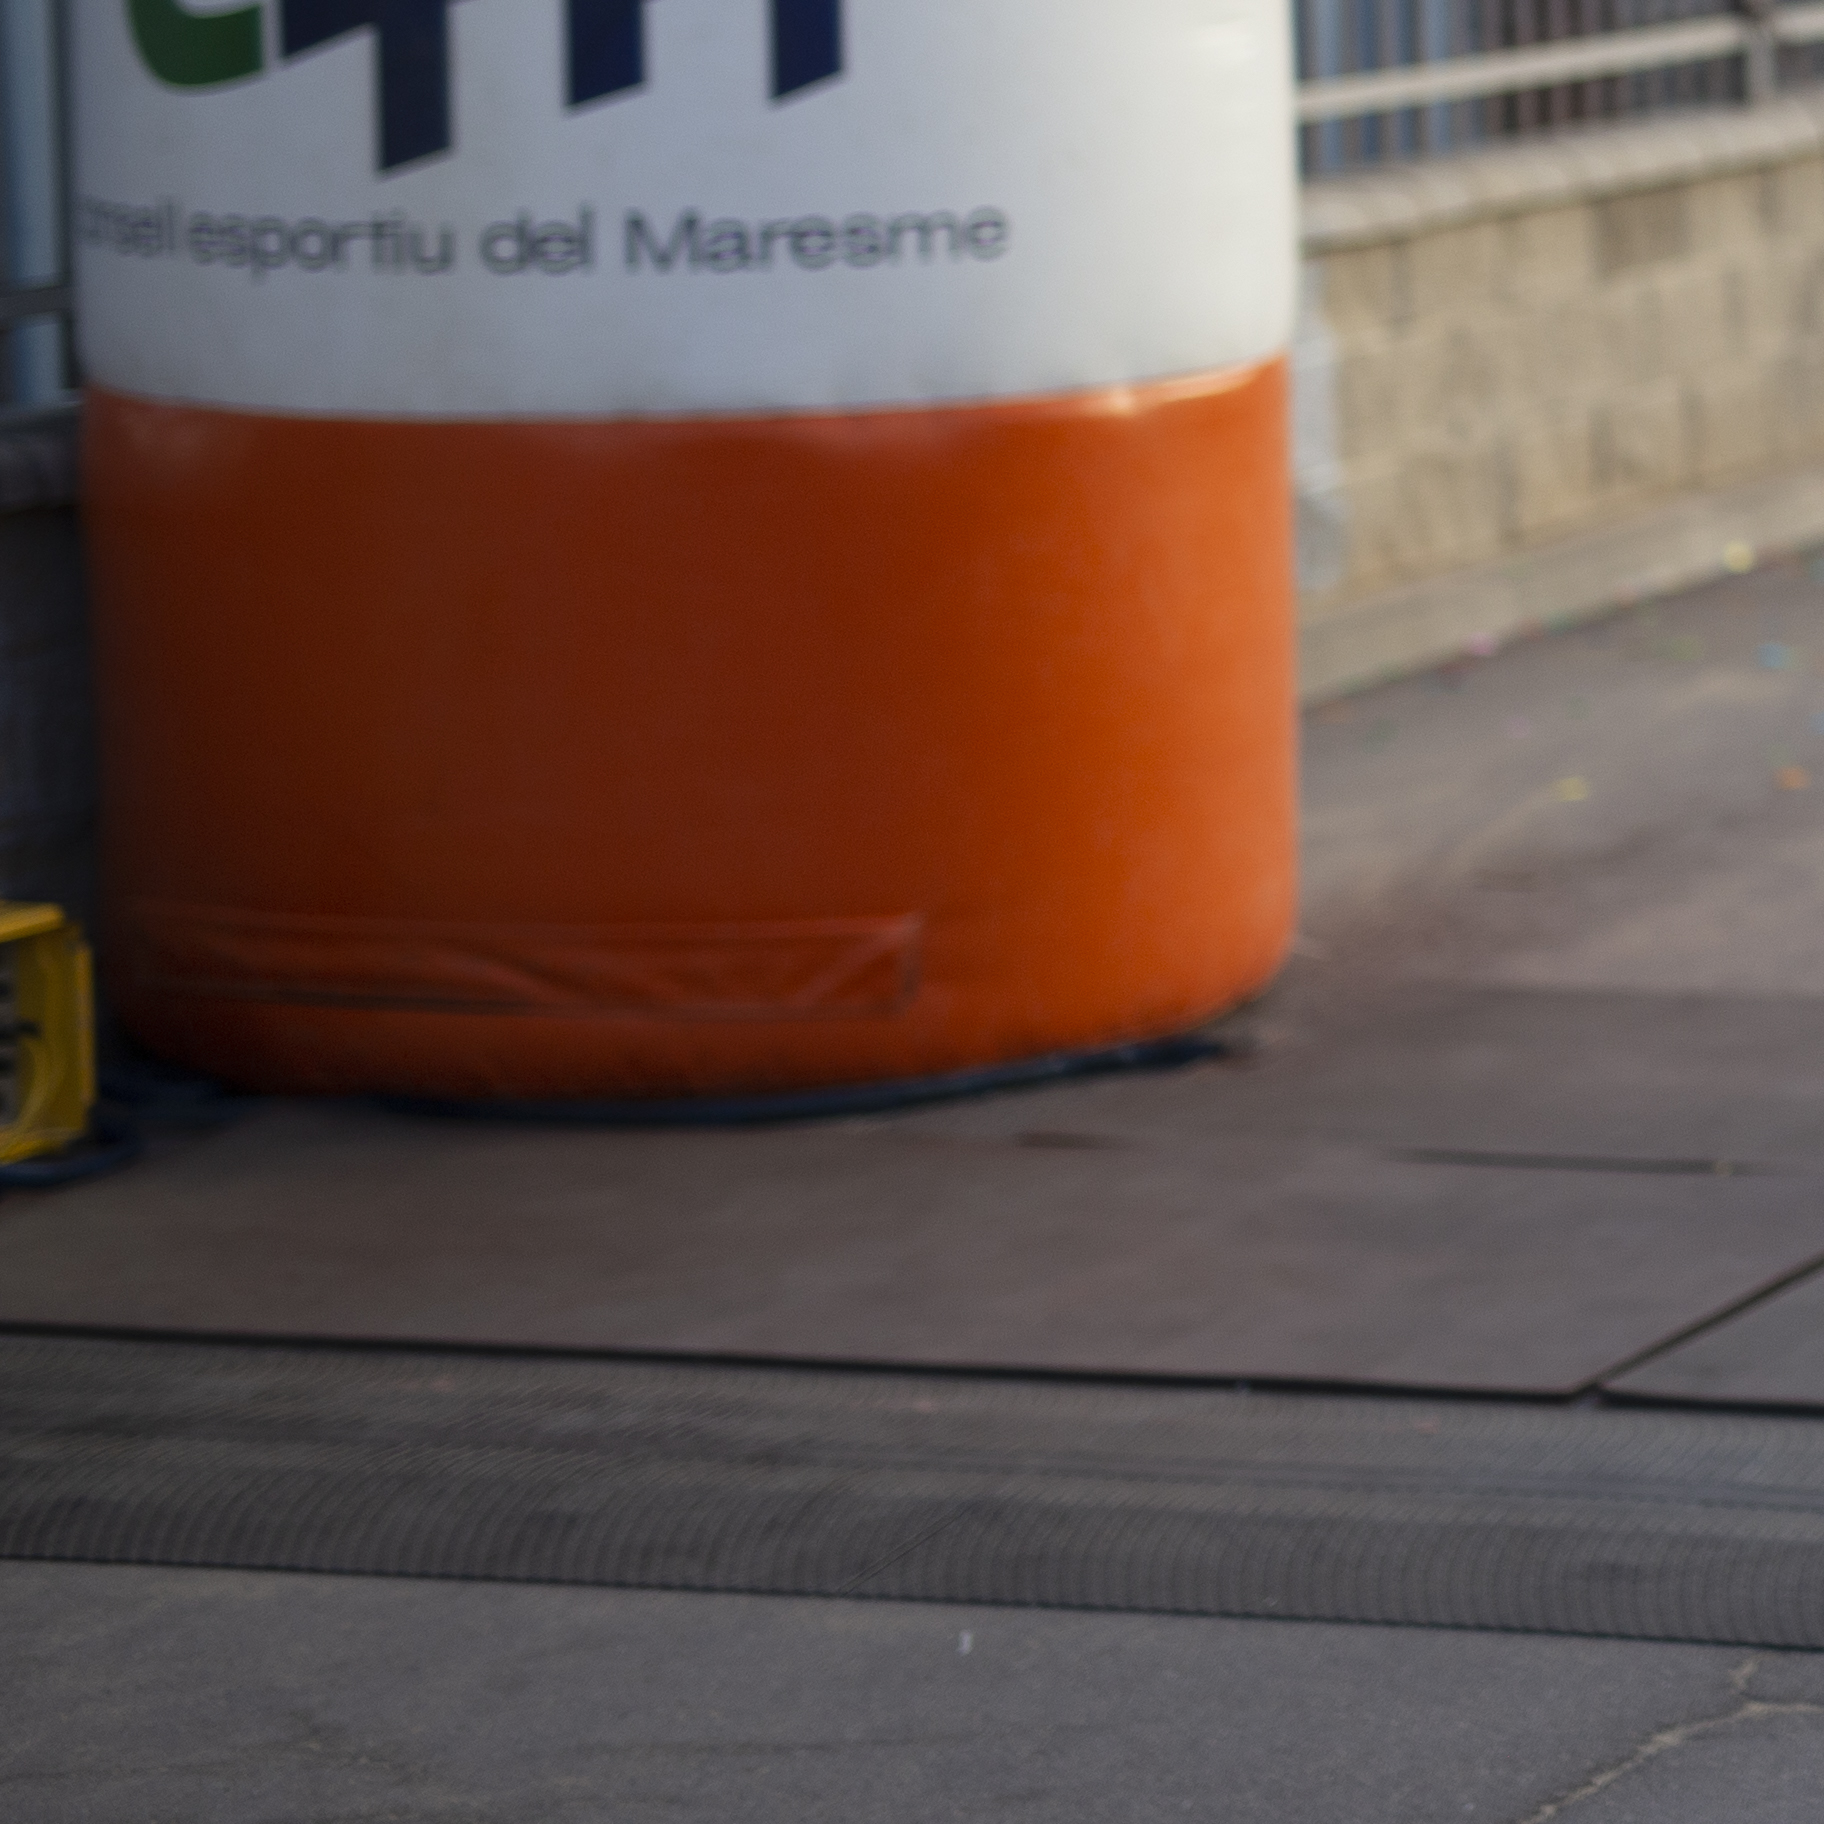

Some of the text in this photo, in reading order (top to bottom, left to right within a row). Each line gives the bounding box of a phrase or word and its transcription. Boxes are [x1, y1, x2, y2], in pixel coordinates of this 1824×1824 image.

[187, 207, 458, 281] esportiu
[479, 201, 595, 275] del
[623, 205, 1008, 272] Maresme
